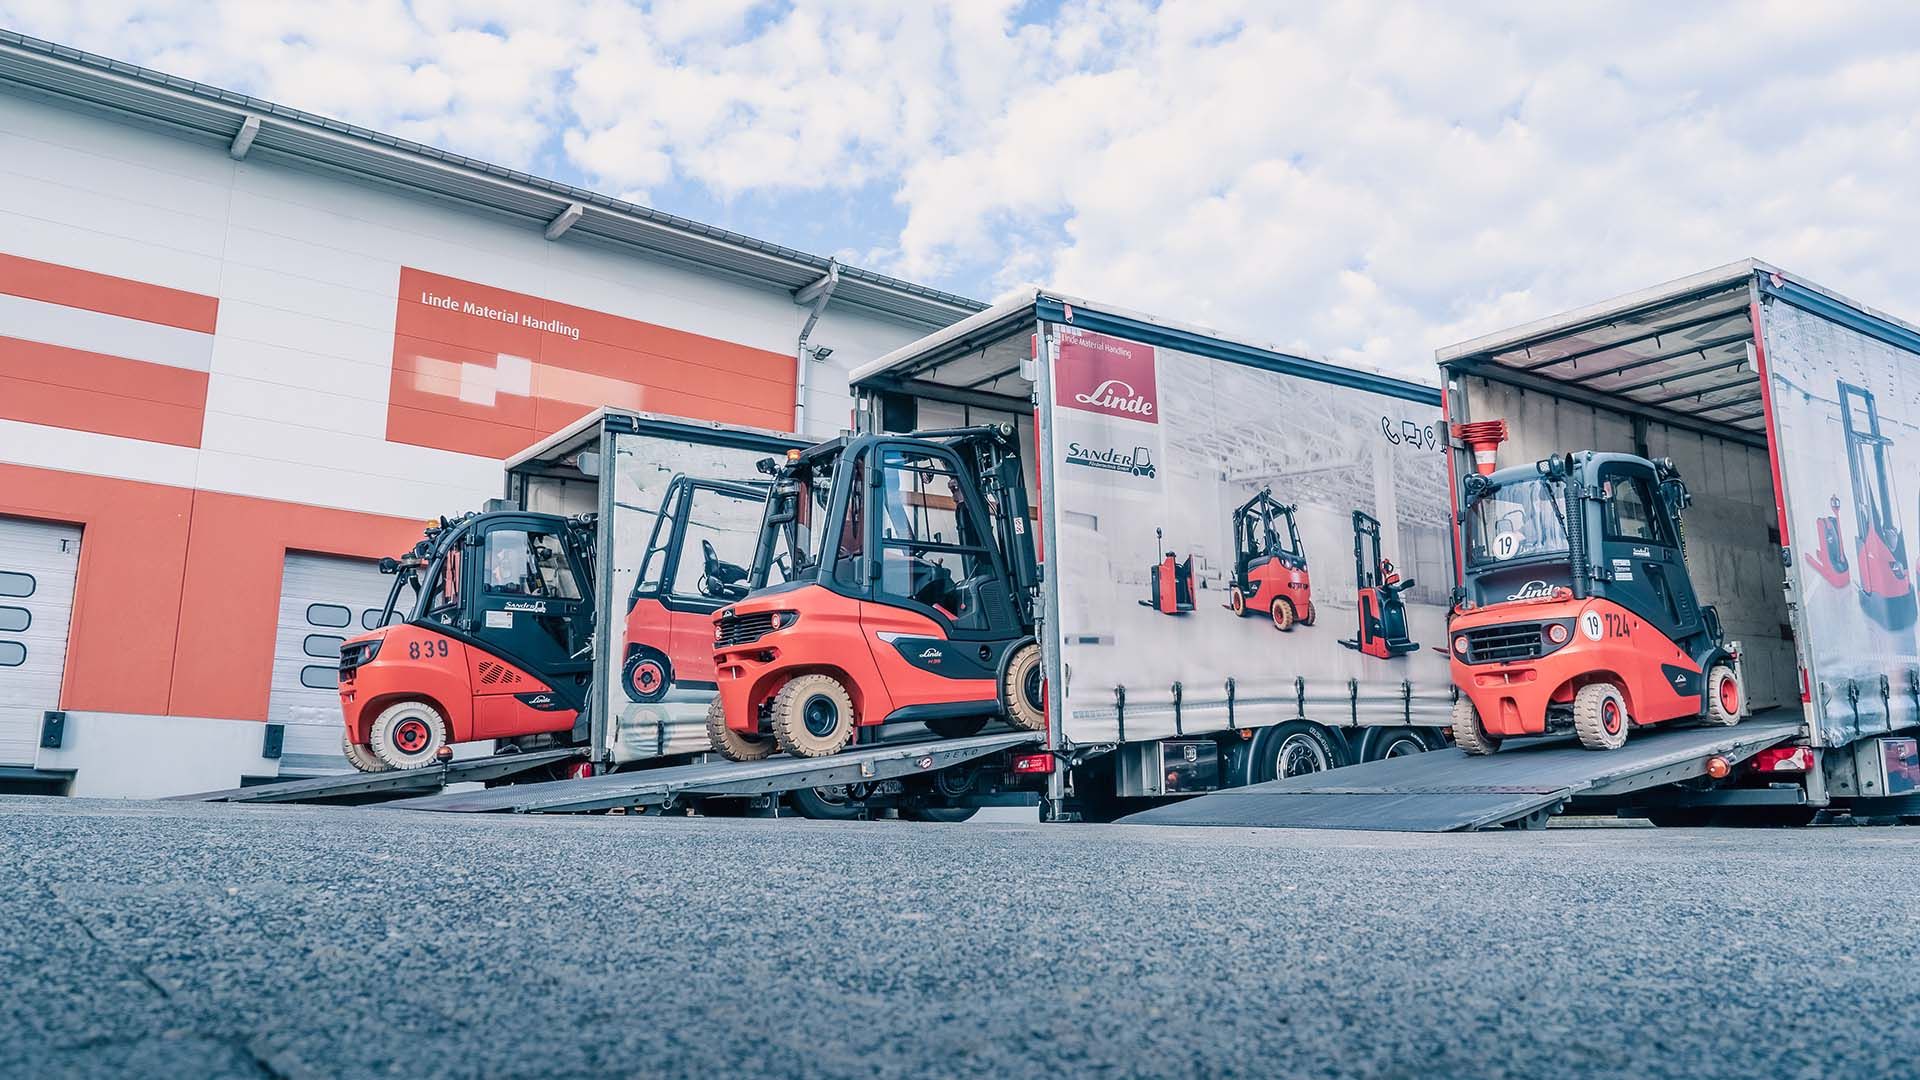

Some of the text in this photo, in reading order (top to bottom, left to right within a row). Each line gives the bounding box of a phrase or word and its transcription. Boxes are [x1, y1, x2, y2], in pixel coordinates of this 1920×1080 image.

[421, 292, 580, 340] Linde Material Handling
[1080, 338, 1104, 350] Material
[1105, 343, 1132, 359] Handling
[1075, 380, 1153, 415] Linde
[1499, 536, 1512, 555] 19
[1587, 616, 1599, 635] 19
[1605, 613, 1630, 638] 724
[410, 640, 448, 660] 839
[919, 648, 942, 658] Linde
